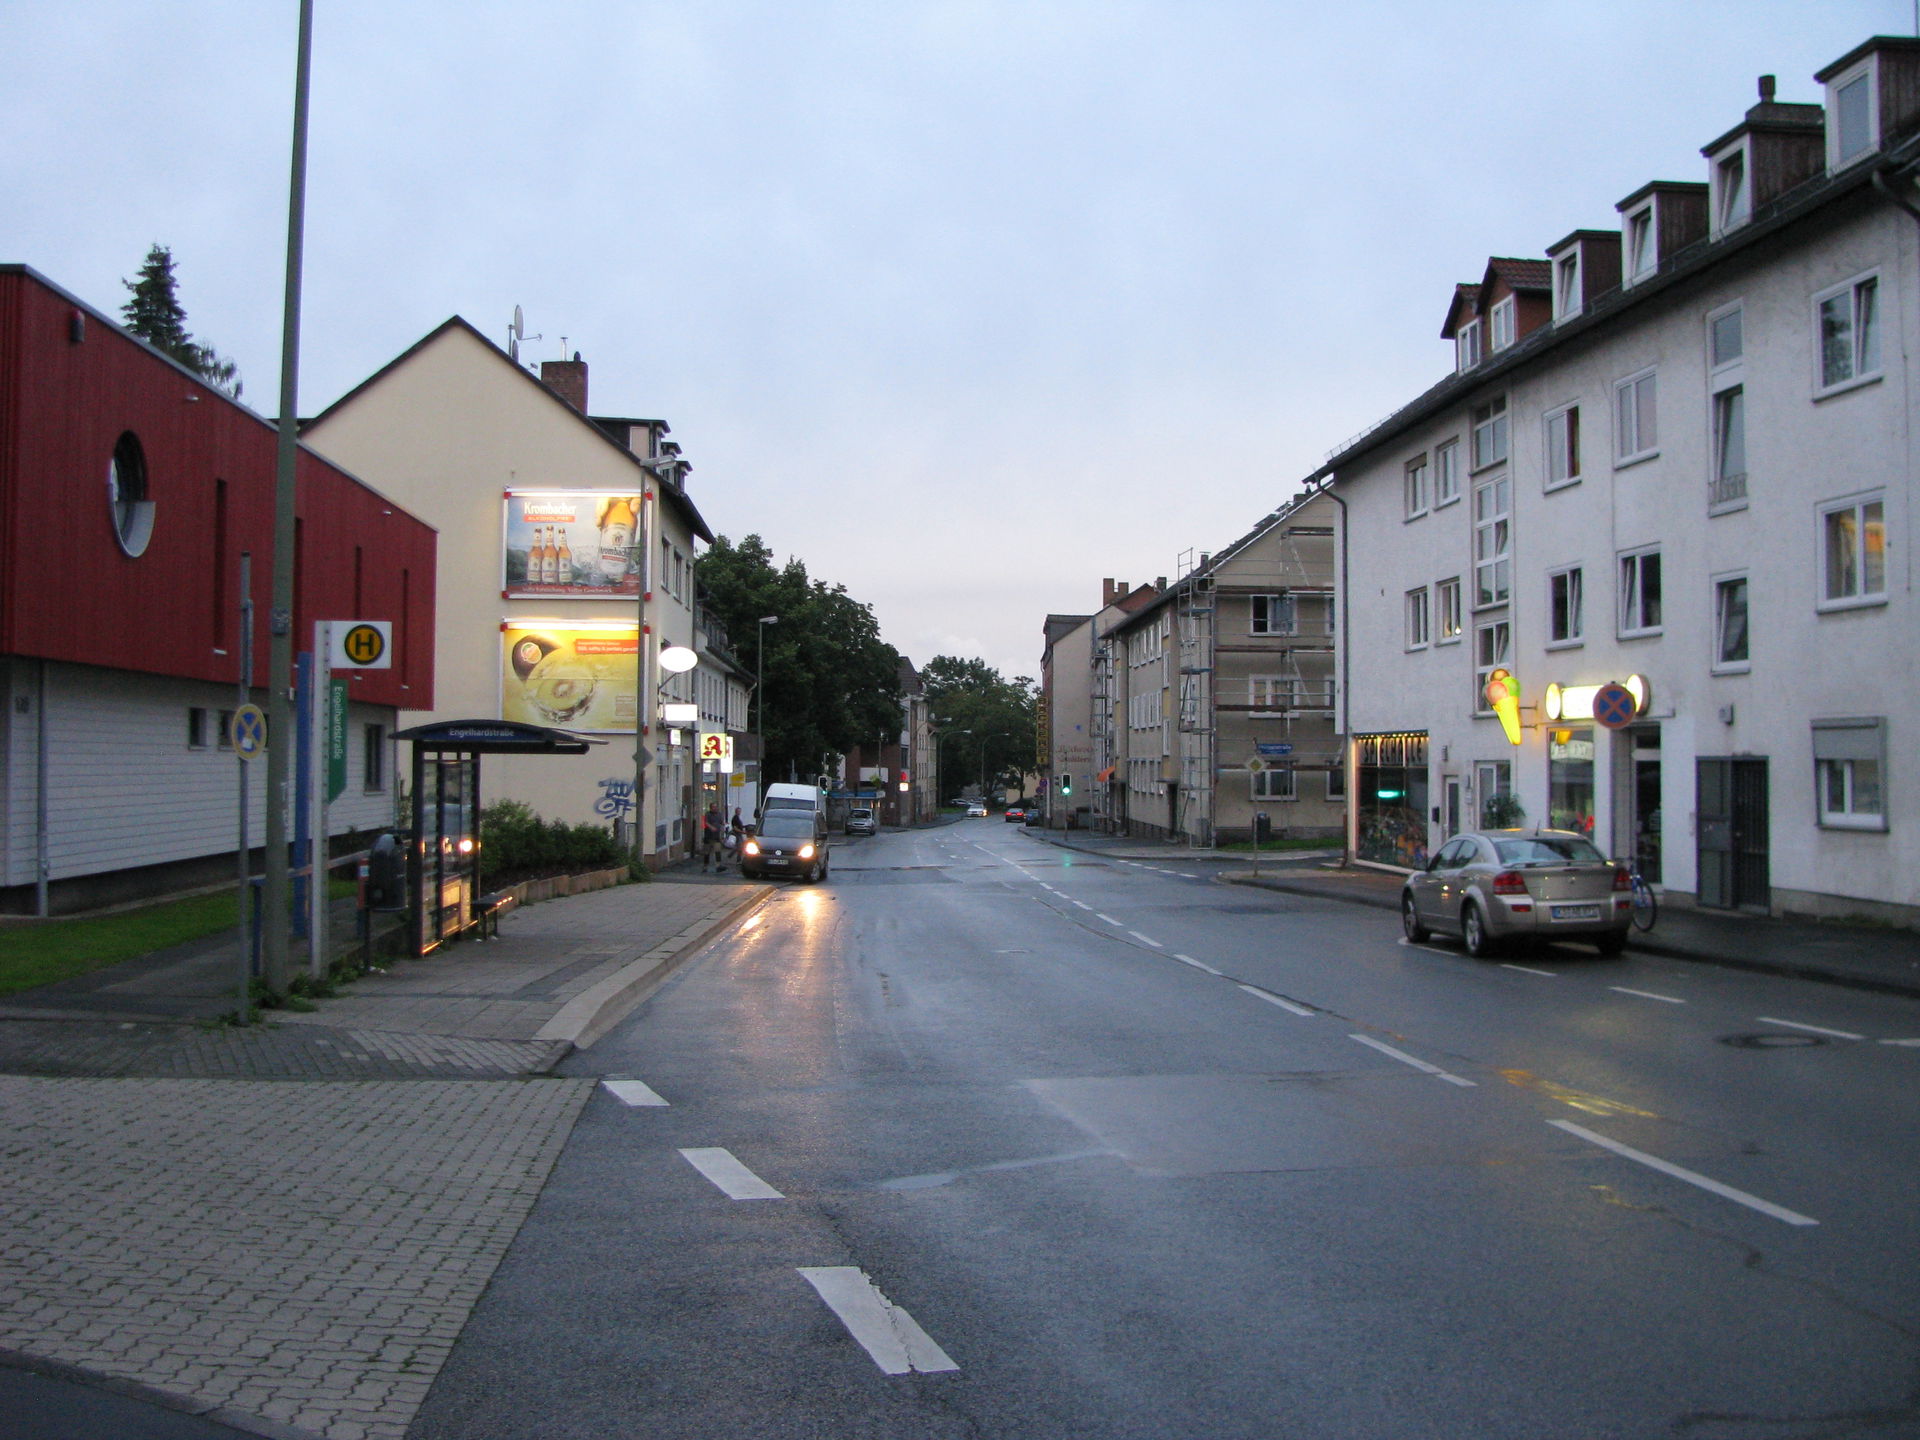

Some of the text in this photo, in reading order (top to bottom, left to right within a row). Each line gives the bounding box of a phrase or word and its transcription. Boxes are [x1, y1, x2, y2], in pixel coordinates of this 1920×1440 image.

[524, 501, 577, 514] Krombacher
[355, 633, 375, 656] H
[334, 686, 344, 760] Engelhardstraße
[448, 727, 514, 738] Engelhardstraße
[703, 735, 723, 757] A
